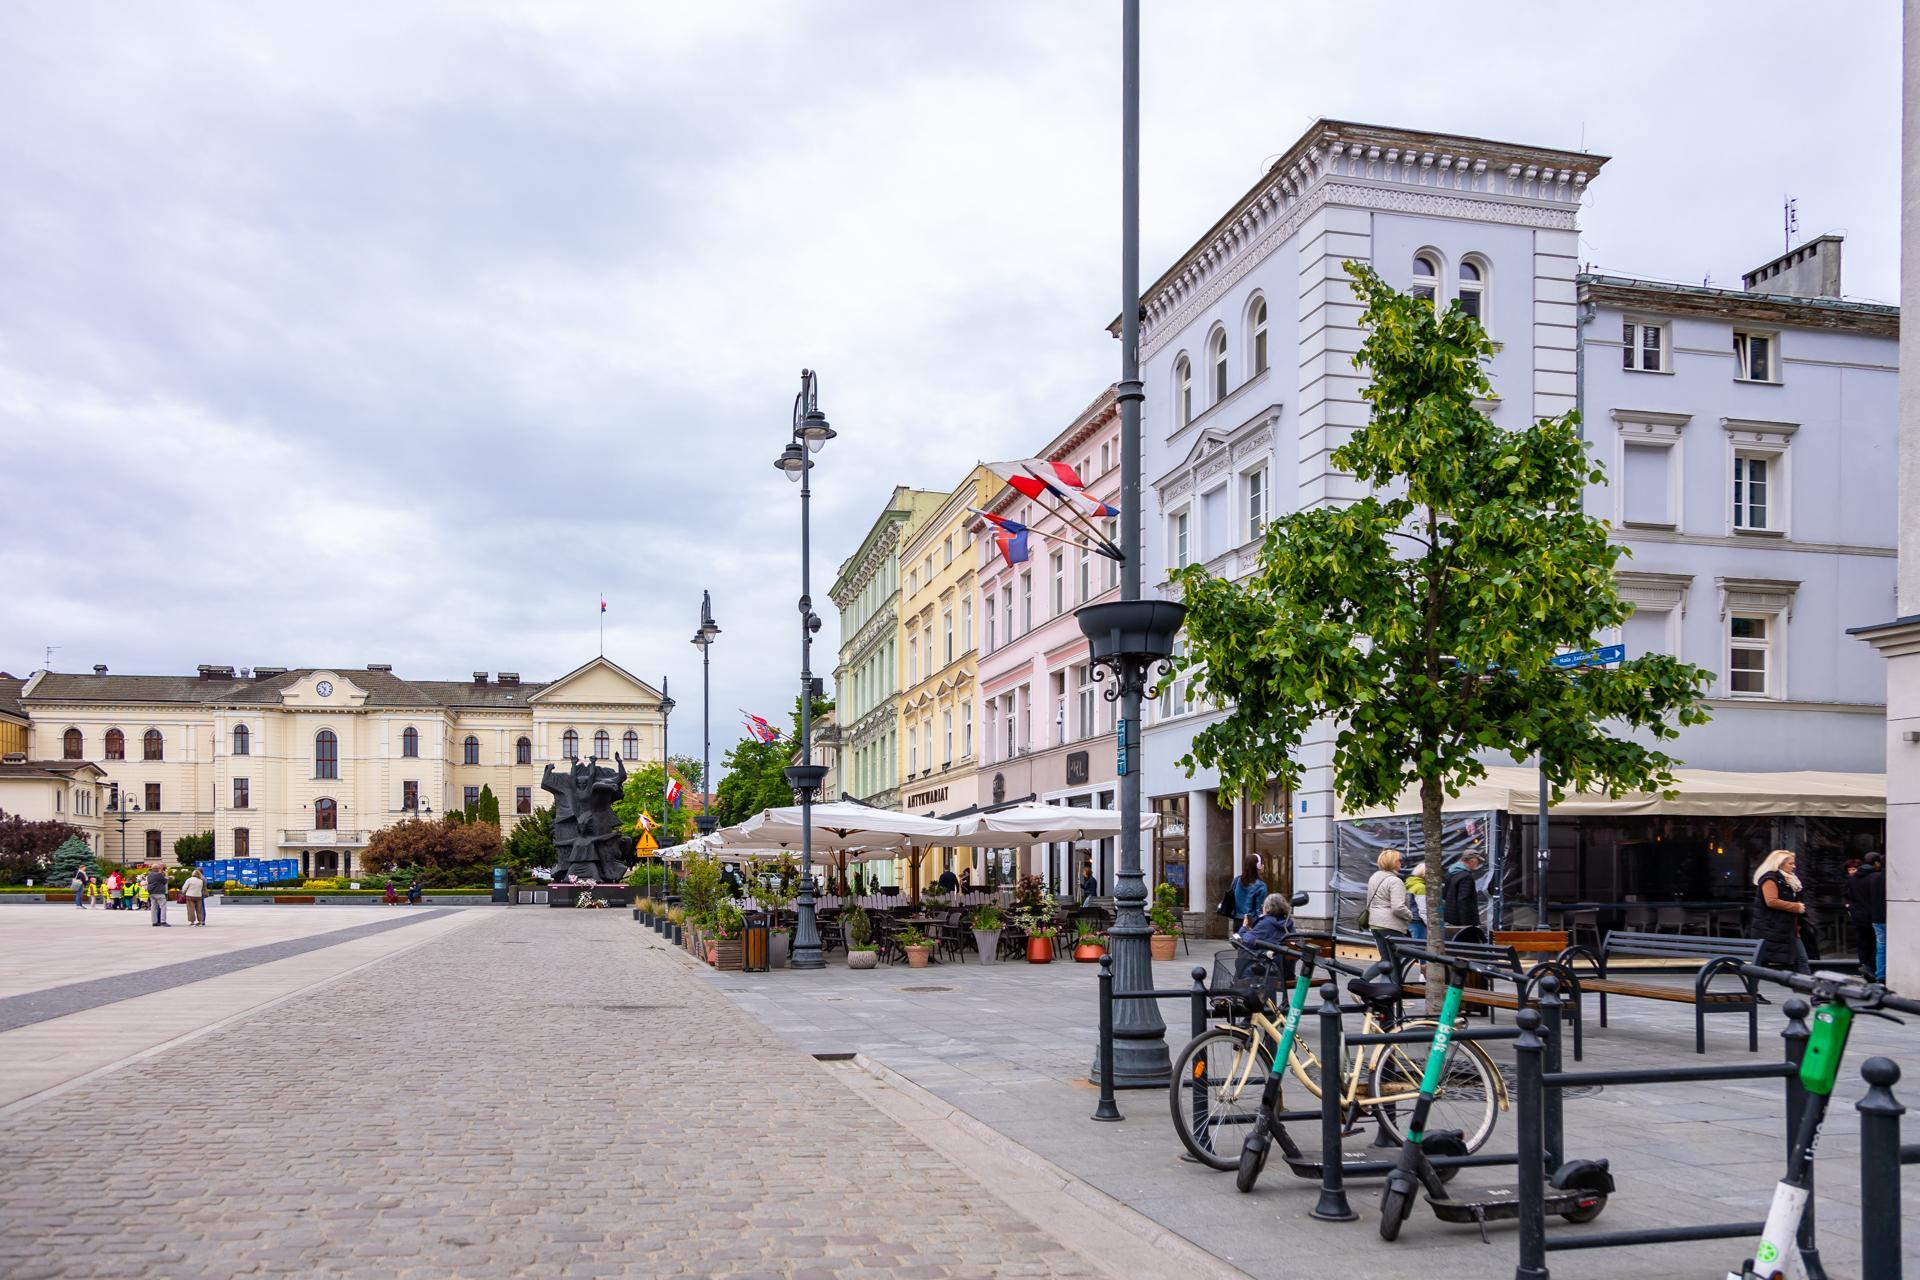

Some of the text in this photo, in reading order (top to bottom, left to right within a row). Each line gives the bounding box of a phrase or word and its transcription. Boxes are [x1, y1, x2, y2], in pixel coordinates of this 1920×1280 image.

[907, 786, 949, 808] ANTYKWARIAT
[1287, 1007, 1300, 1032] Bolt
[1434, 1023, 1451, 1052] Bolt
